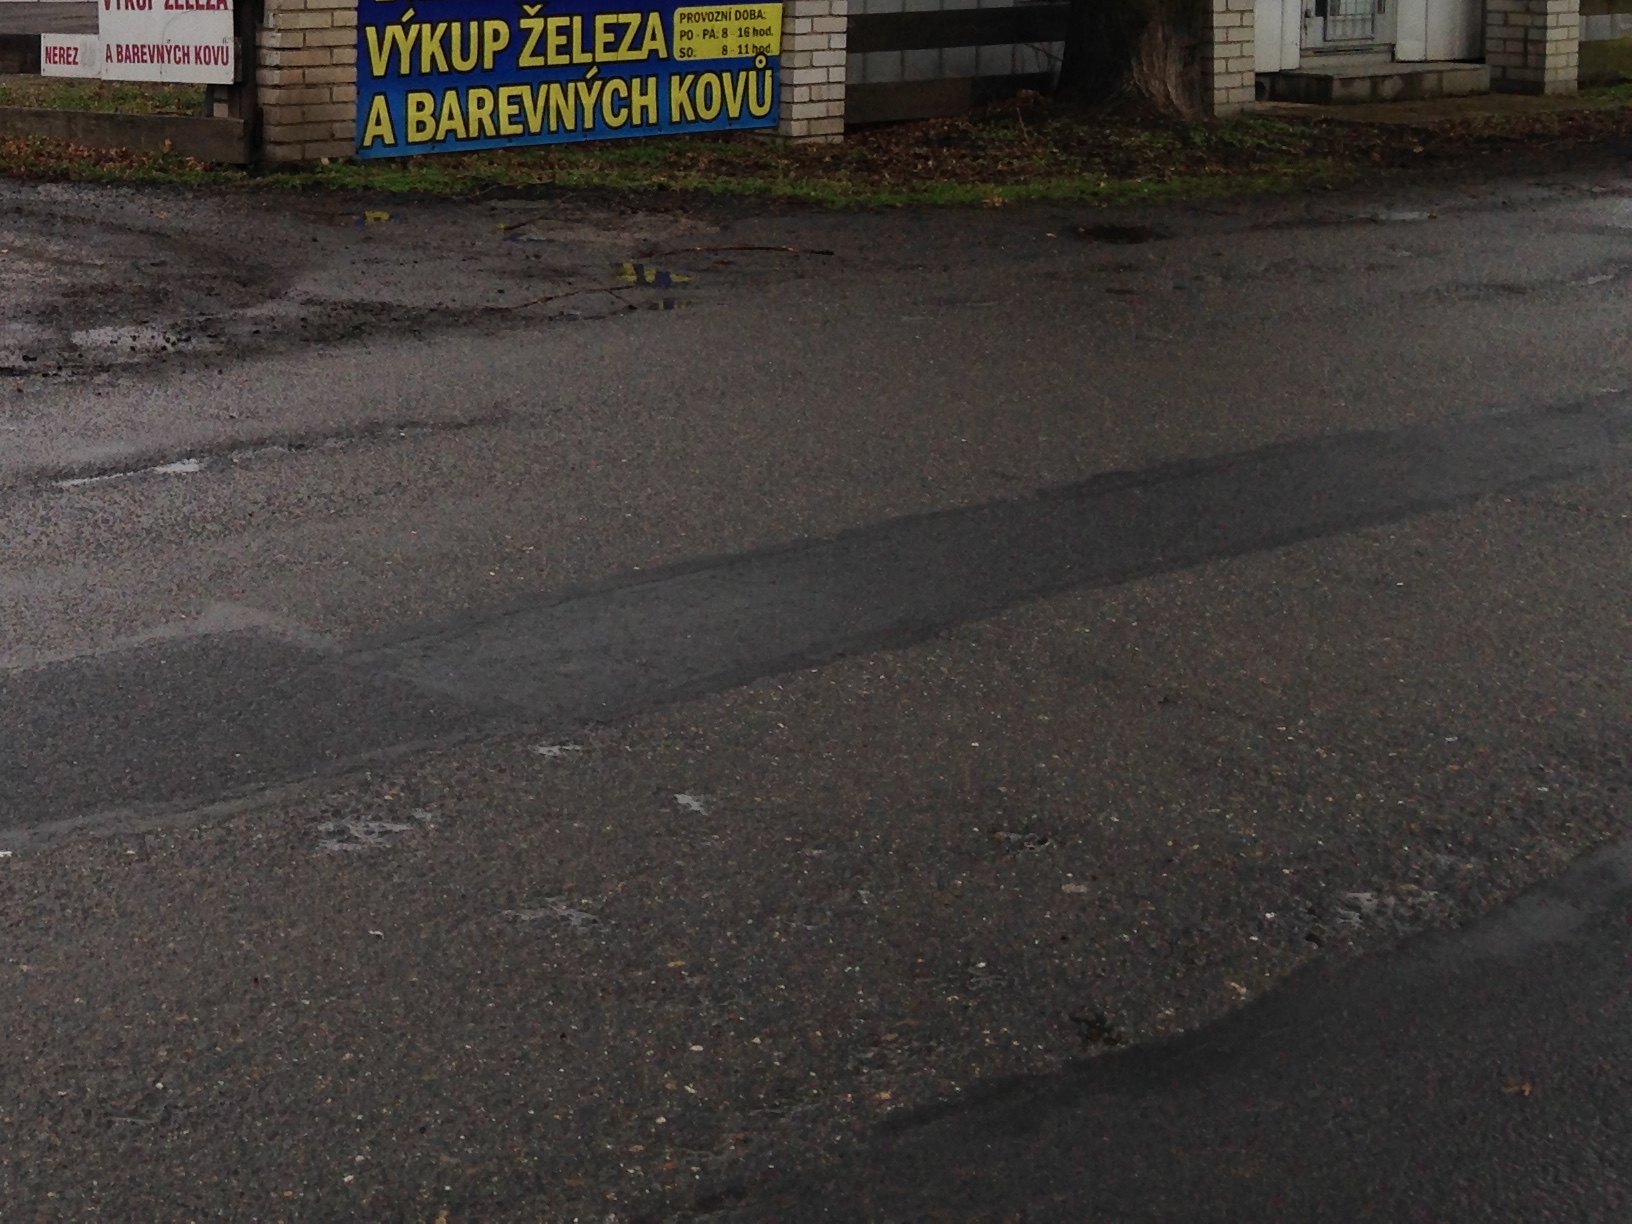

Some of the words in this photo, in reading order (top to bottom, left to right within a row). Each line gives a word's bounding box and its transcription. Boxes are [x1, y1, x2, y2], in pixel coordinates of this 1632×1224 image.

[679, 7, 731, 24] PROVOZNÍ
[365, 7, 510, 77] VÝKUP
[518, 4, 668, 68] ŽELEZA
[679, 29, 694, 41] PO
[721, 27, 728, 39] 8
[737, 26, 750, 38] 16
[45, 46, 79, 65] NEREZ
[106, 44, 113, 63] A
[117, 39, 190, 66] BAREVNÝCH
[721, 45, 728, 55] 8
[737, 43, 749, 55] 11
[363, 95, 395, 147] A
[407, 65, 658, 143] BAREVNÝCH
[670, 55, 773, 122] KOVŮ
